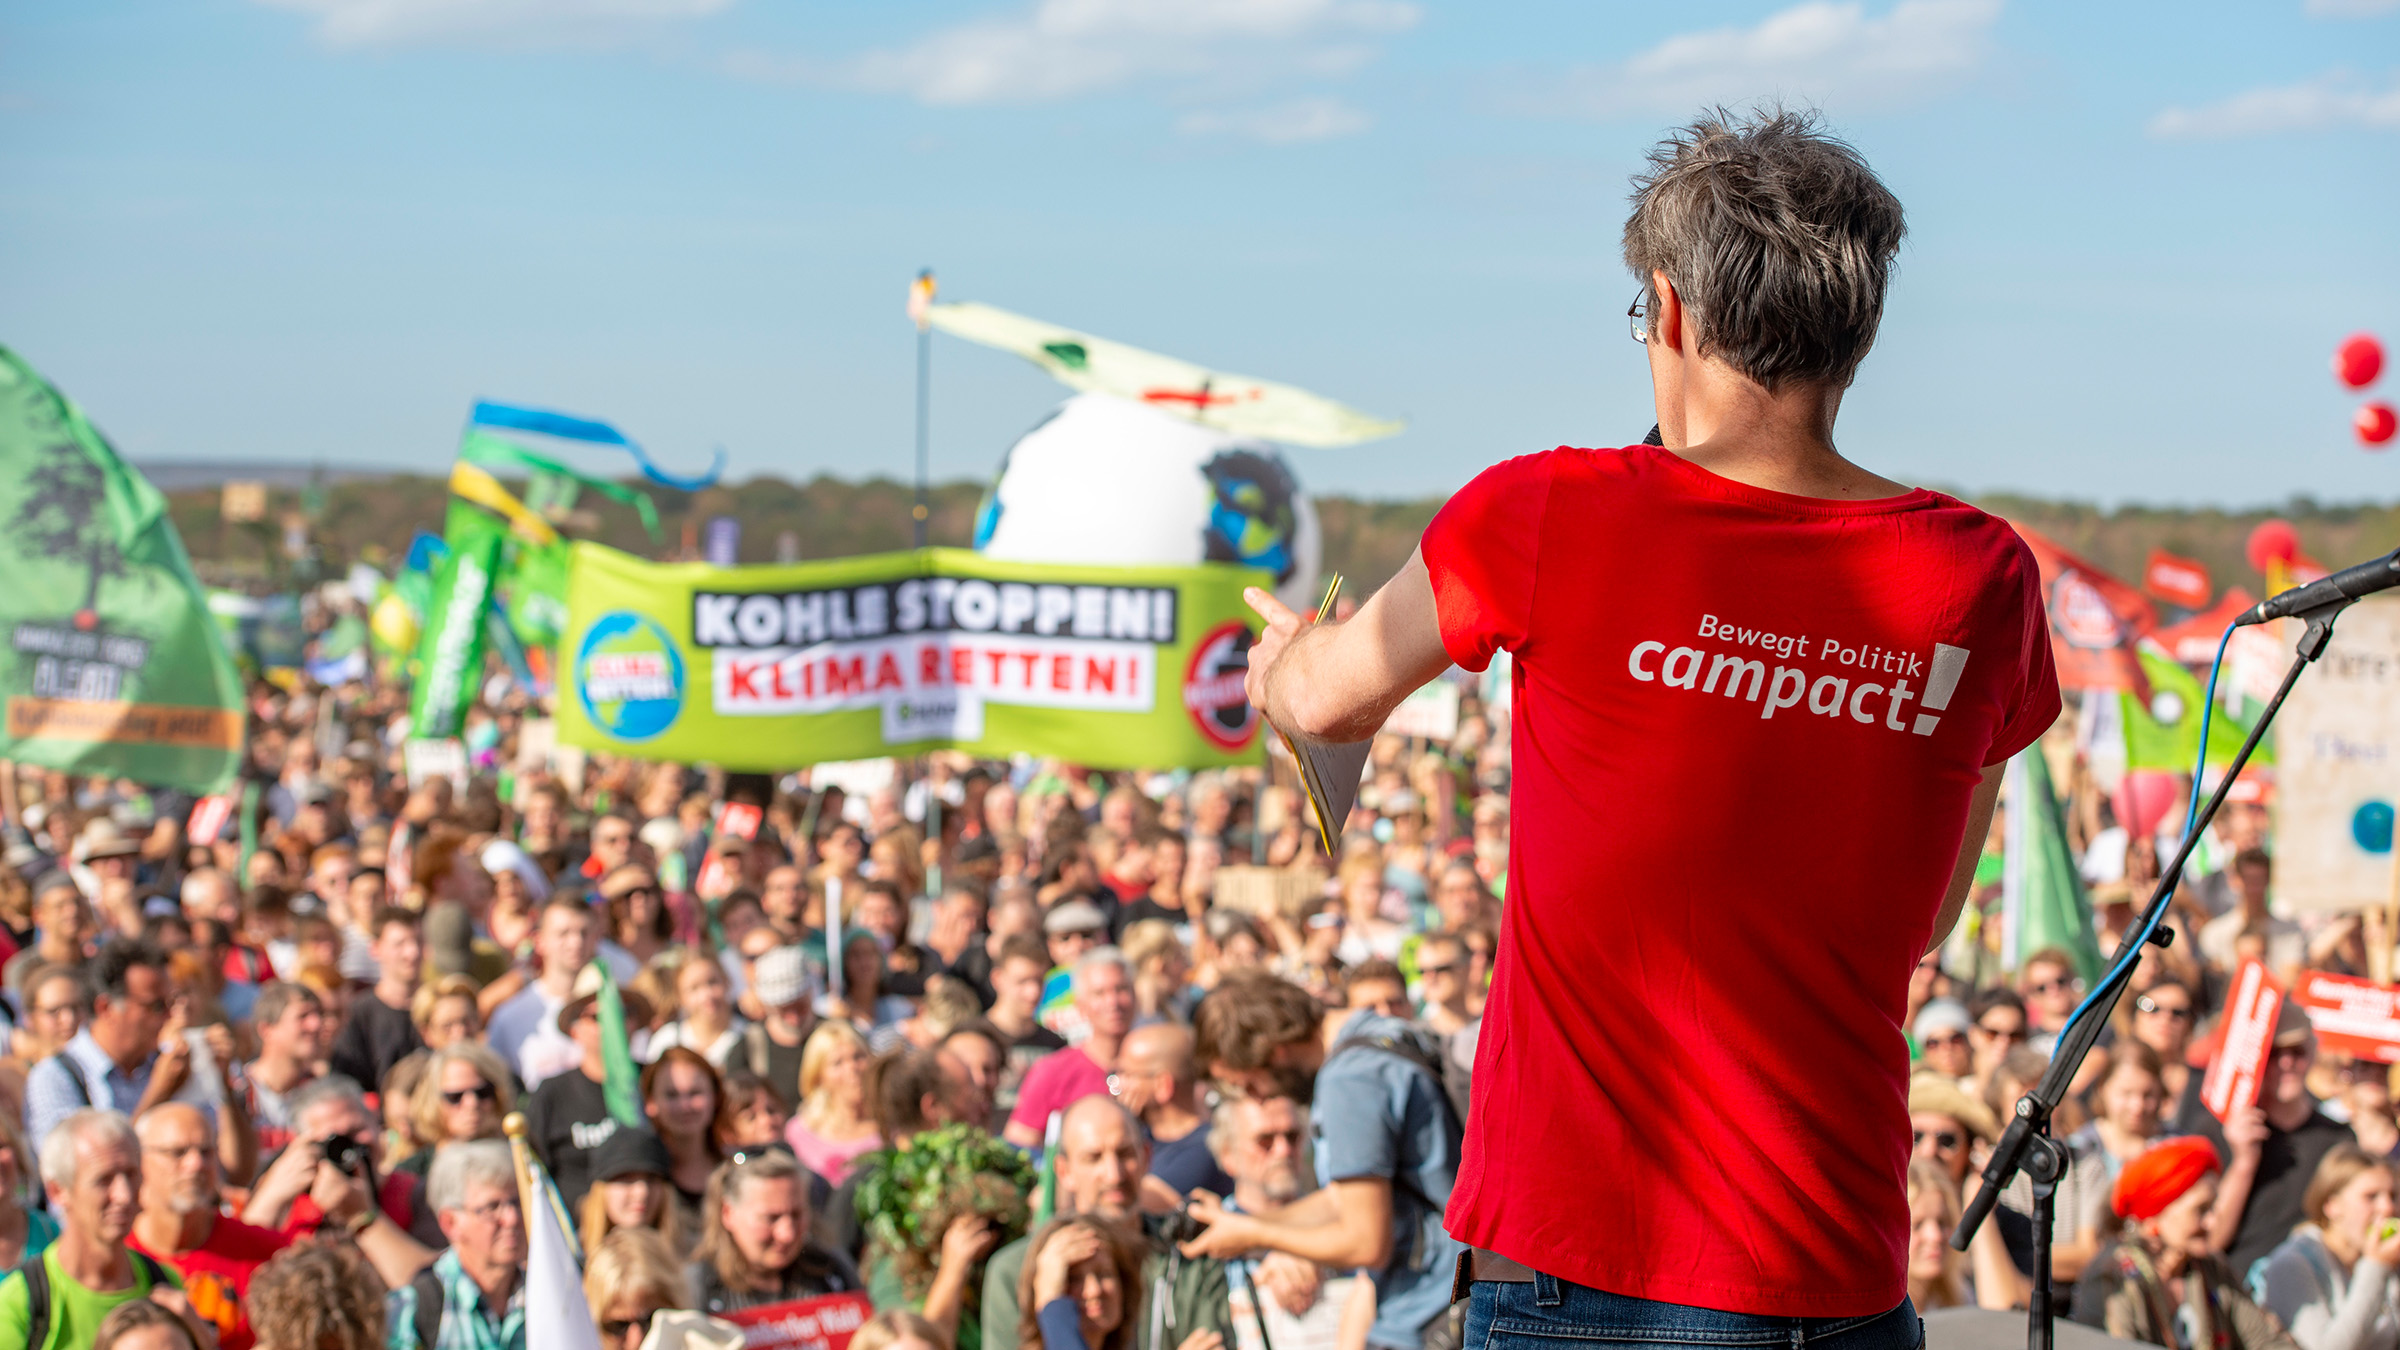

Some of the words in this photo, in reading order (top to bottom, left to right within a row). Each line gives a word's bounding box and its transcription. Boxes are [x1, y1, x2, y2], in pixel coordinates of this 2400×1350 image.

[696, 585, 888, 645] KOHLE
[896, 578, 1174, 638] STOPPEN!
[730, 652, 902, 699] KLIMA
[920, 646, 1137, 698] RETTEN!
[1698, 614, 1809, 658] Bewegt
[1820, 639, 1922, 677] Politik
[1628, 640, 1970, 736] campact!
